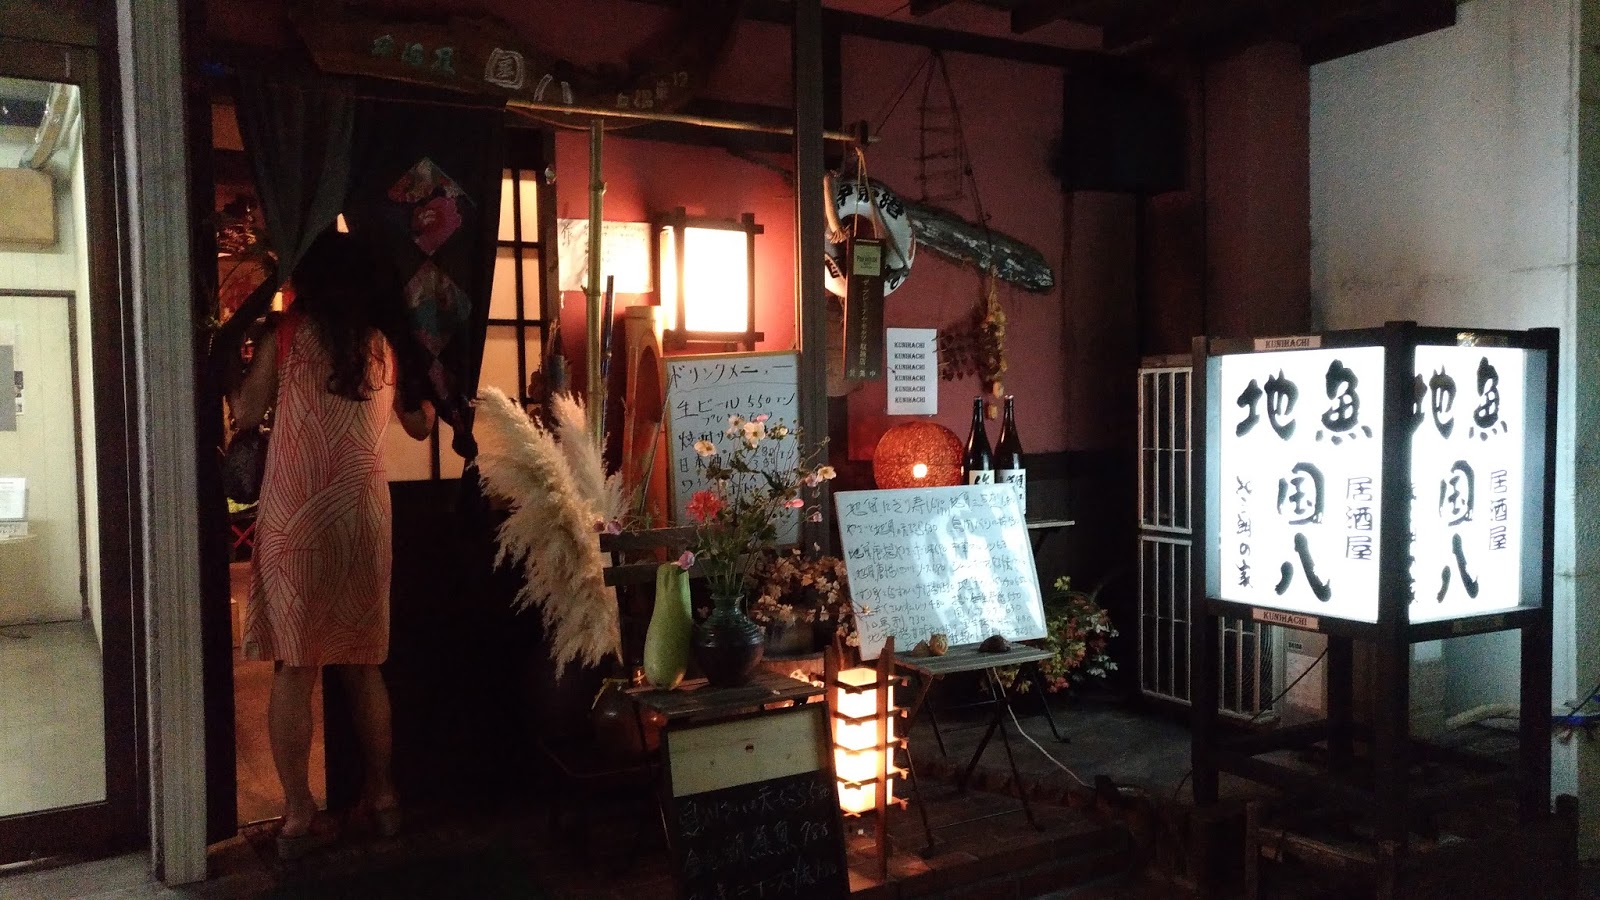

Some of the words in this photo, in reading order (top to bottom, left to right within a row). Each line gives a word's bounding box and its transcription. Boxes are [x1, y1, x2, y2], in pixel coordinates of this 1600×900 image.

[1265, 338, 1310, 348] KUNIHACHI
[1274, 459, 1332, 603] 国八
[1345, 476, 1373, 561] 居酒屋
[1436, 459, 1480, 604] 国八
[1488, 469, 1508, 552] 居酒屋
[1263, 611, 1307, 626] KUNIHACHI
